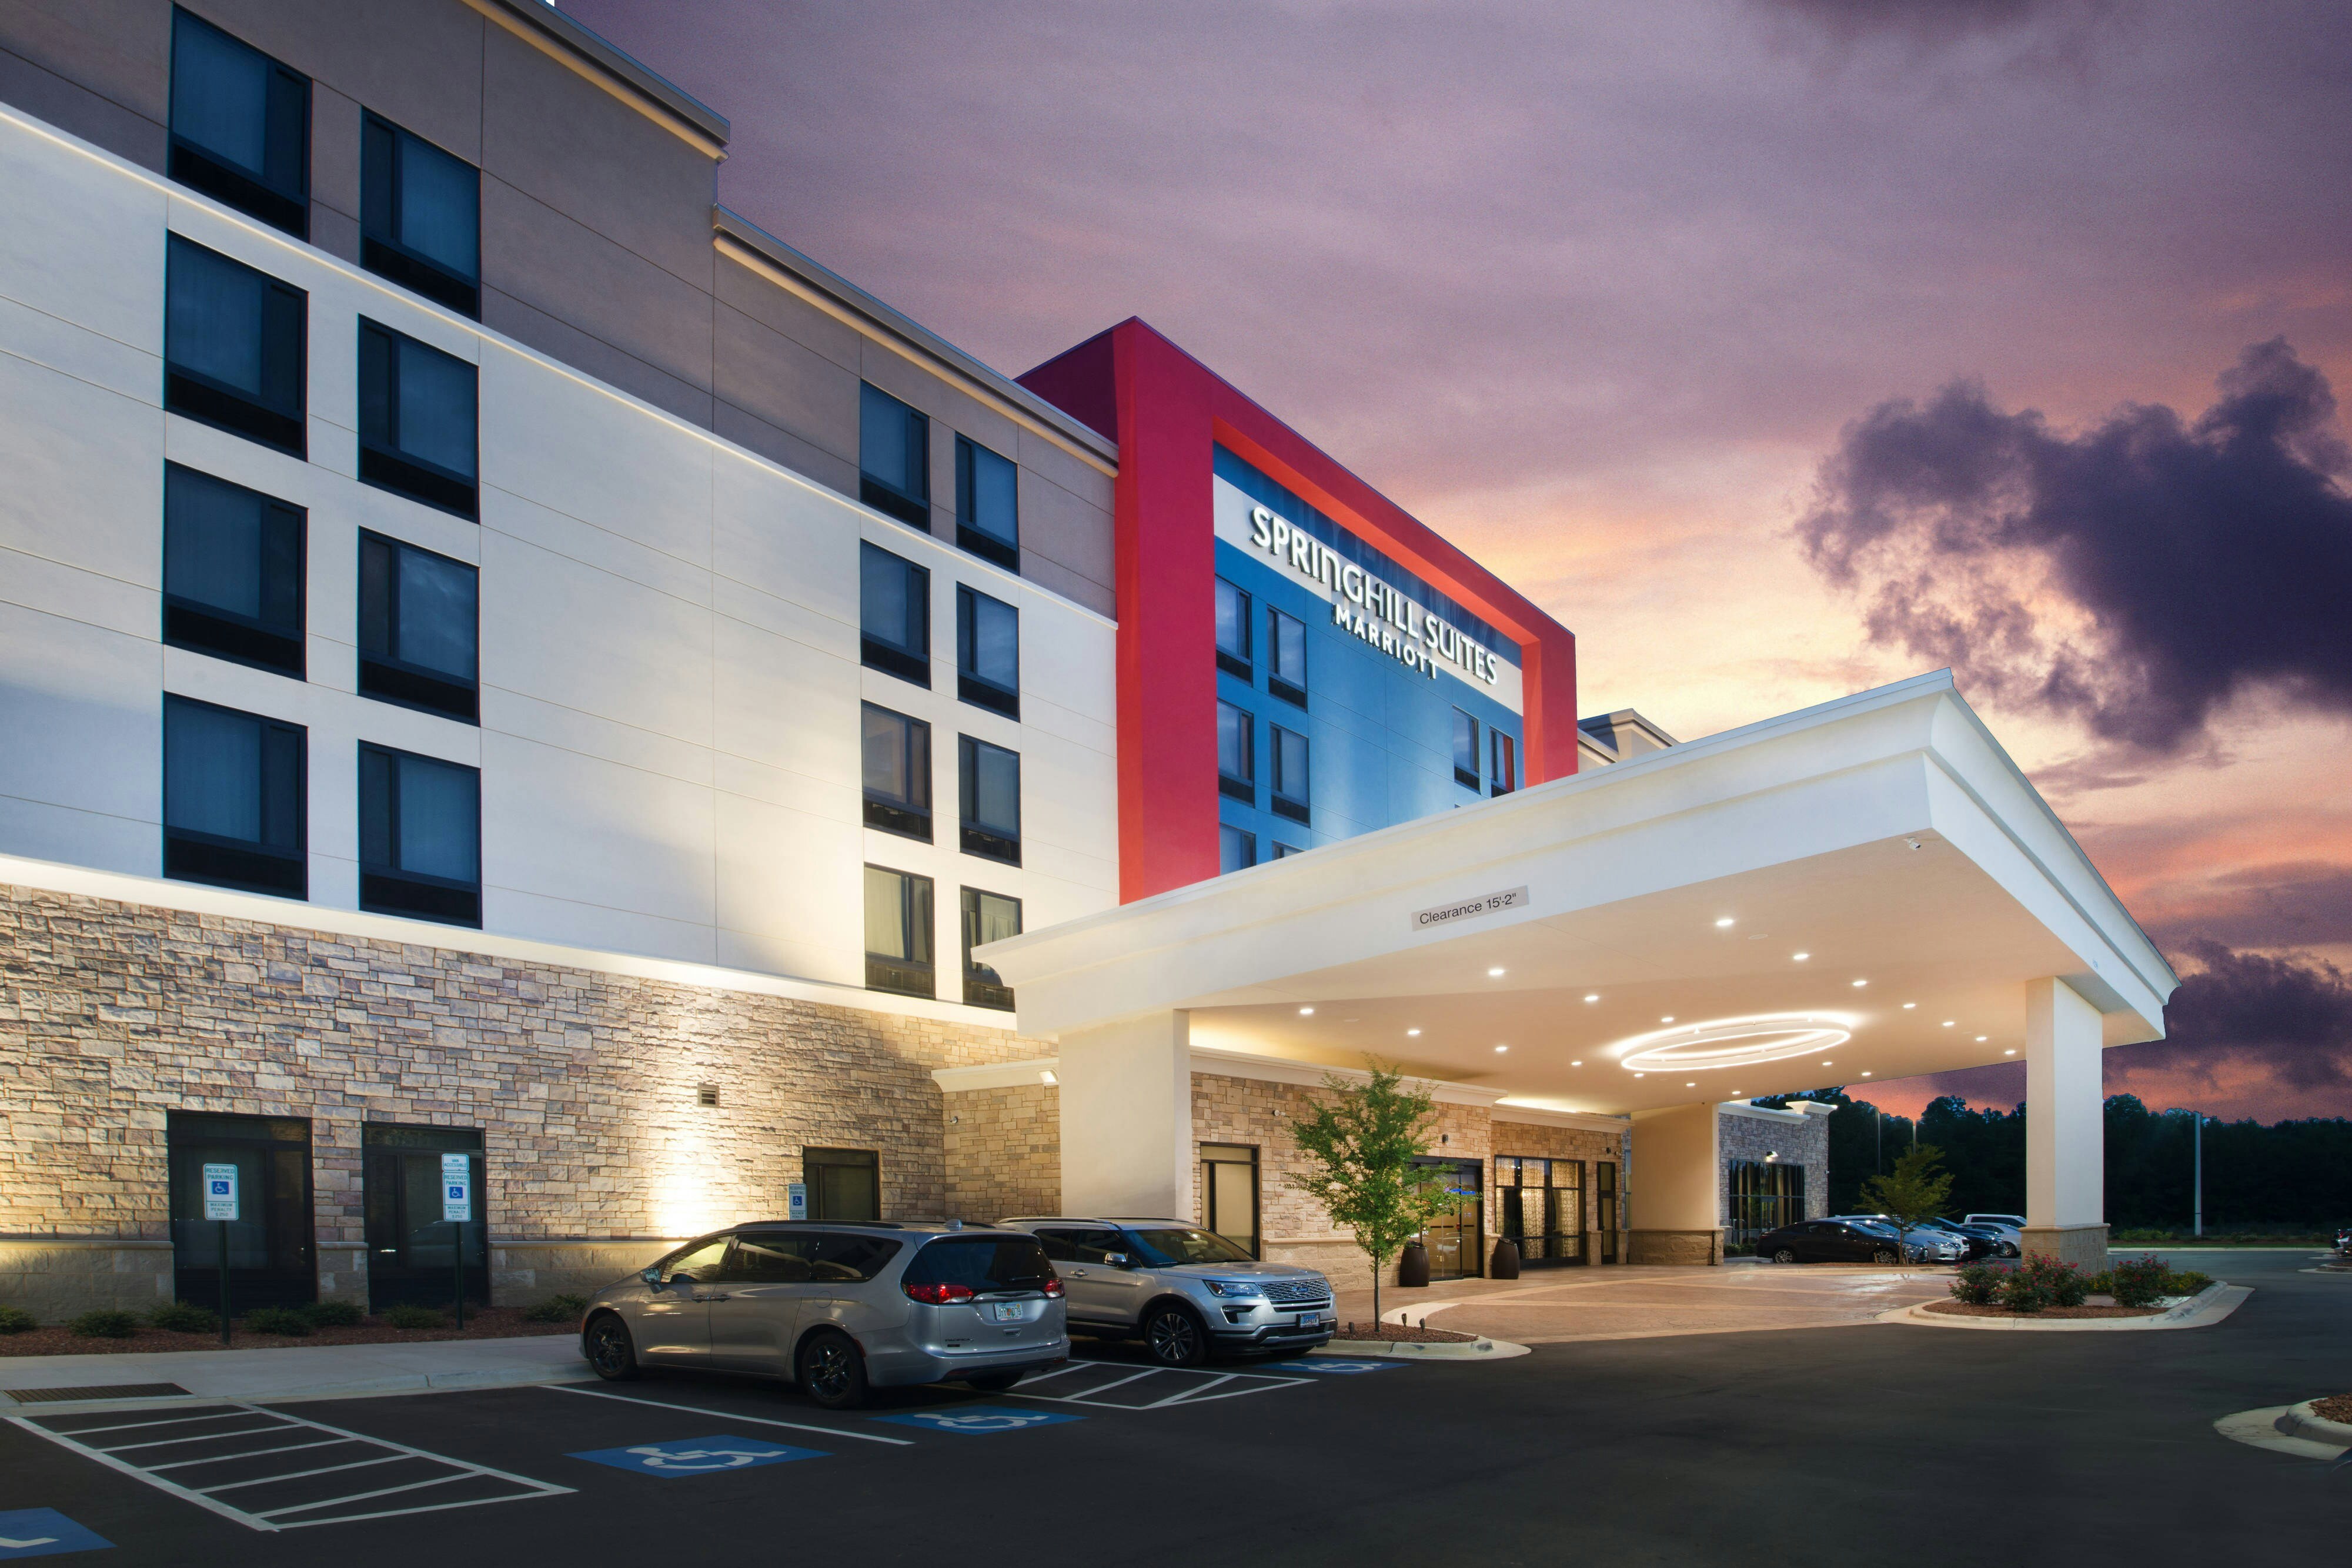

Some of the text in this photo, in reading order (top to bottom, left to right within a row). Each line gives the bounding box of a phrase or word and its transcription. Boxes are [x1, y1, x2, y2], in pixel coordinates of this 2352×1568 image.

[1251, 507, 1498, 685] SPRINGHILL SUITES
[1331, 603, 1439, 680] MARRIOTT
[1419, 892, 1516, 924] Clearance 15'-2"
